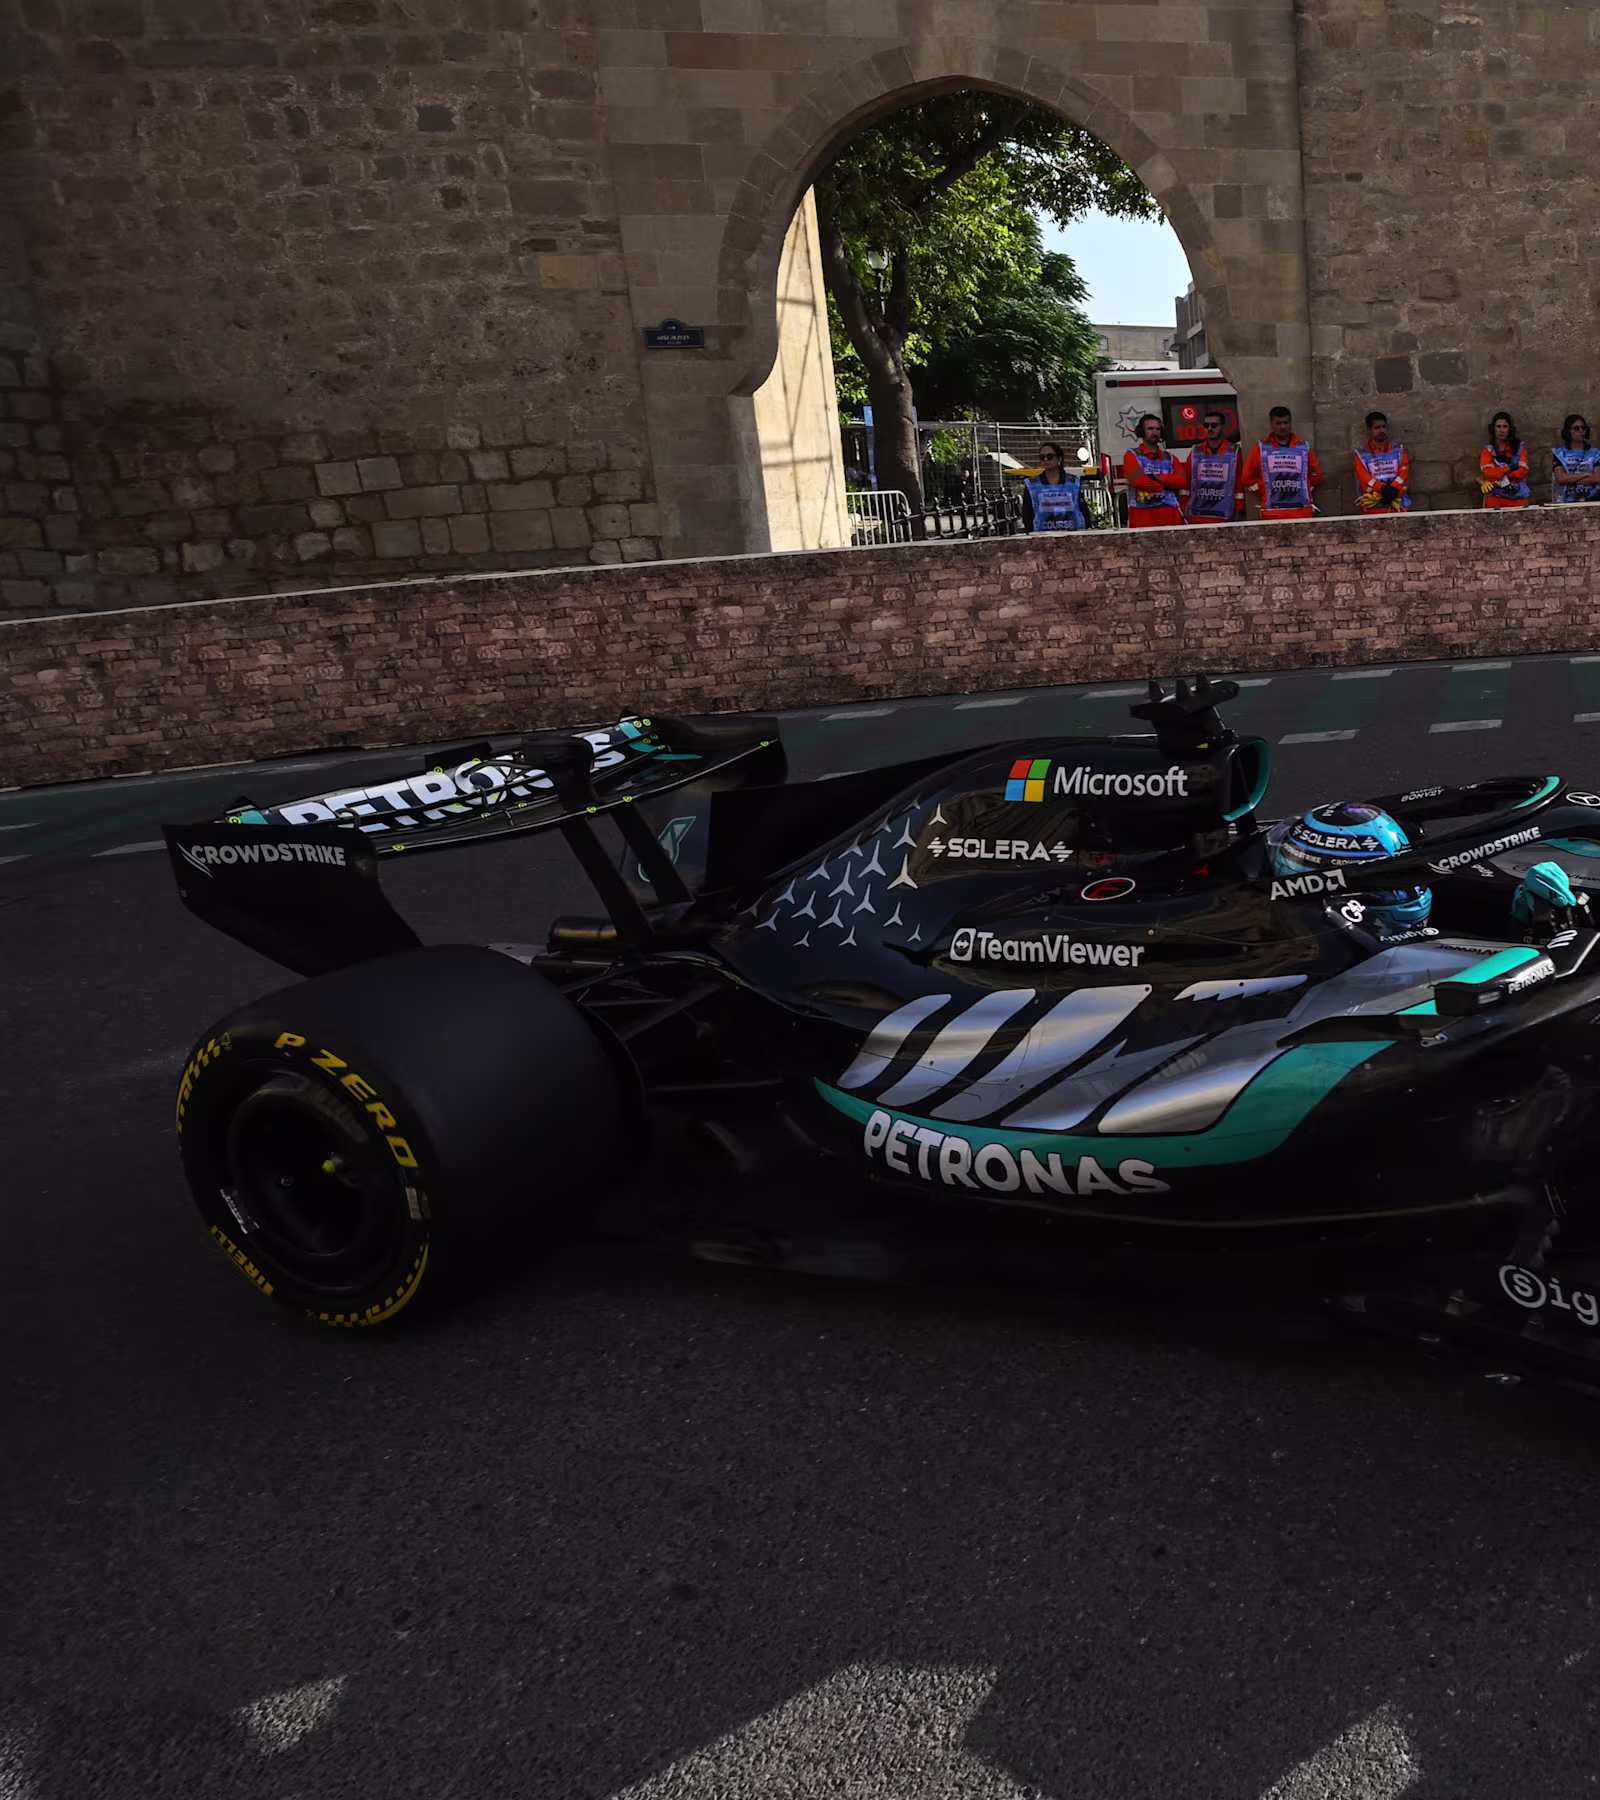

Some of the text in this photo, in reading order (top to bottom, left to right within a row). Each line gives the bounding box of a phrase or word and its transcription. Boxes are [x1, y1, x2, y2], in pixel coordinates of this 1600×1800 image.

[1042, 520, 1076, 530] COURSE
[278, 731, 627, 834] PETRONS
[1053, 765, 1189, 797] Microsoft
[191, 842, 347, 868] CROWDSTRIKE
[946, 838, 1050, 861] SOLERA
[1301, 831, 1361, 851] SOLERA
[1438, 826, 1542, 872] CROWDSTRIKE
[1270, 875, 1325, 901] AMD
[975, 931, 1145, 968] TeamViewer
[1507, 961, 1556, 995] PETRONAS
[274, 1031, 307, 1049] P
[310, 1048, 419, 1169] ZERO
[863, 1109, 1173, 1196] PETRONAS
[209, 1224, 276, 1297] PIRELLI
